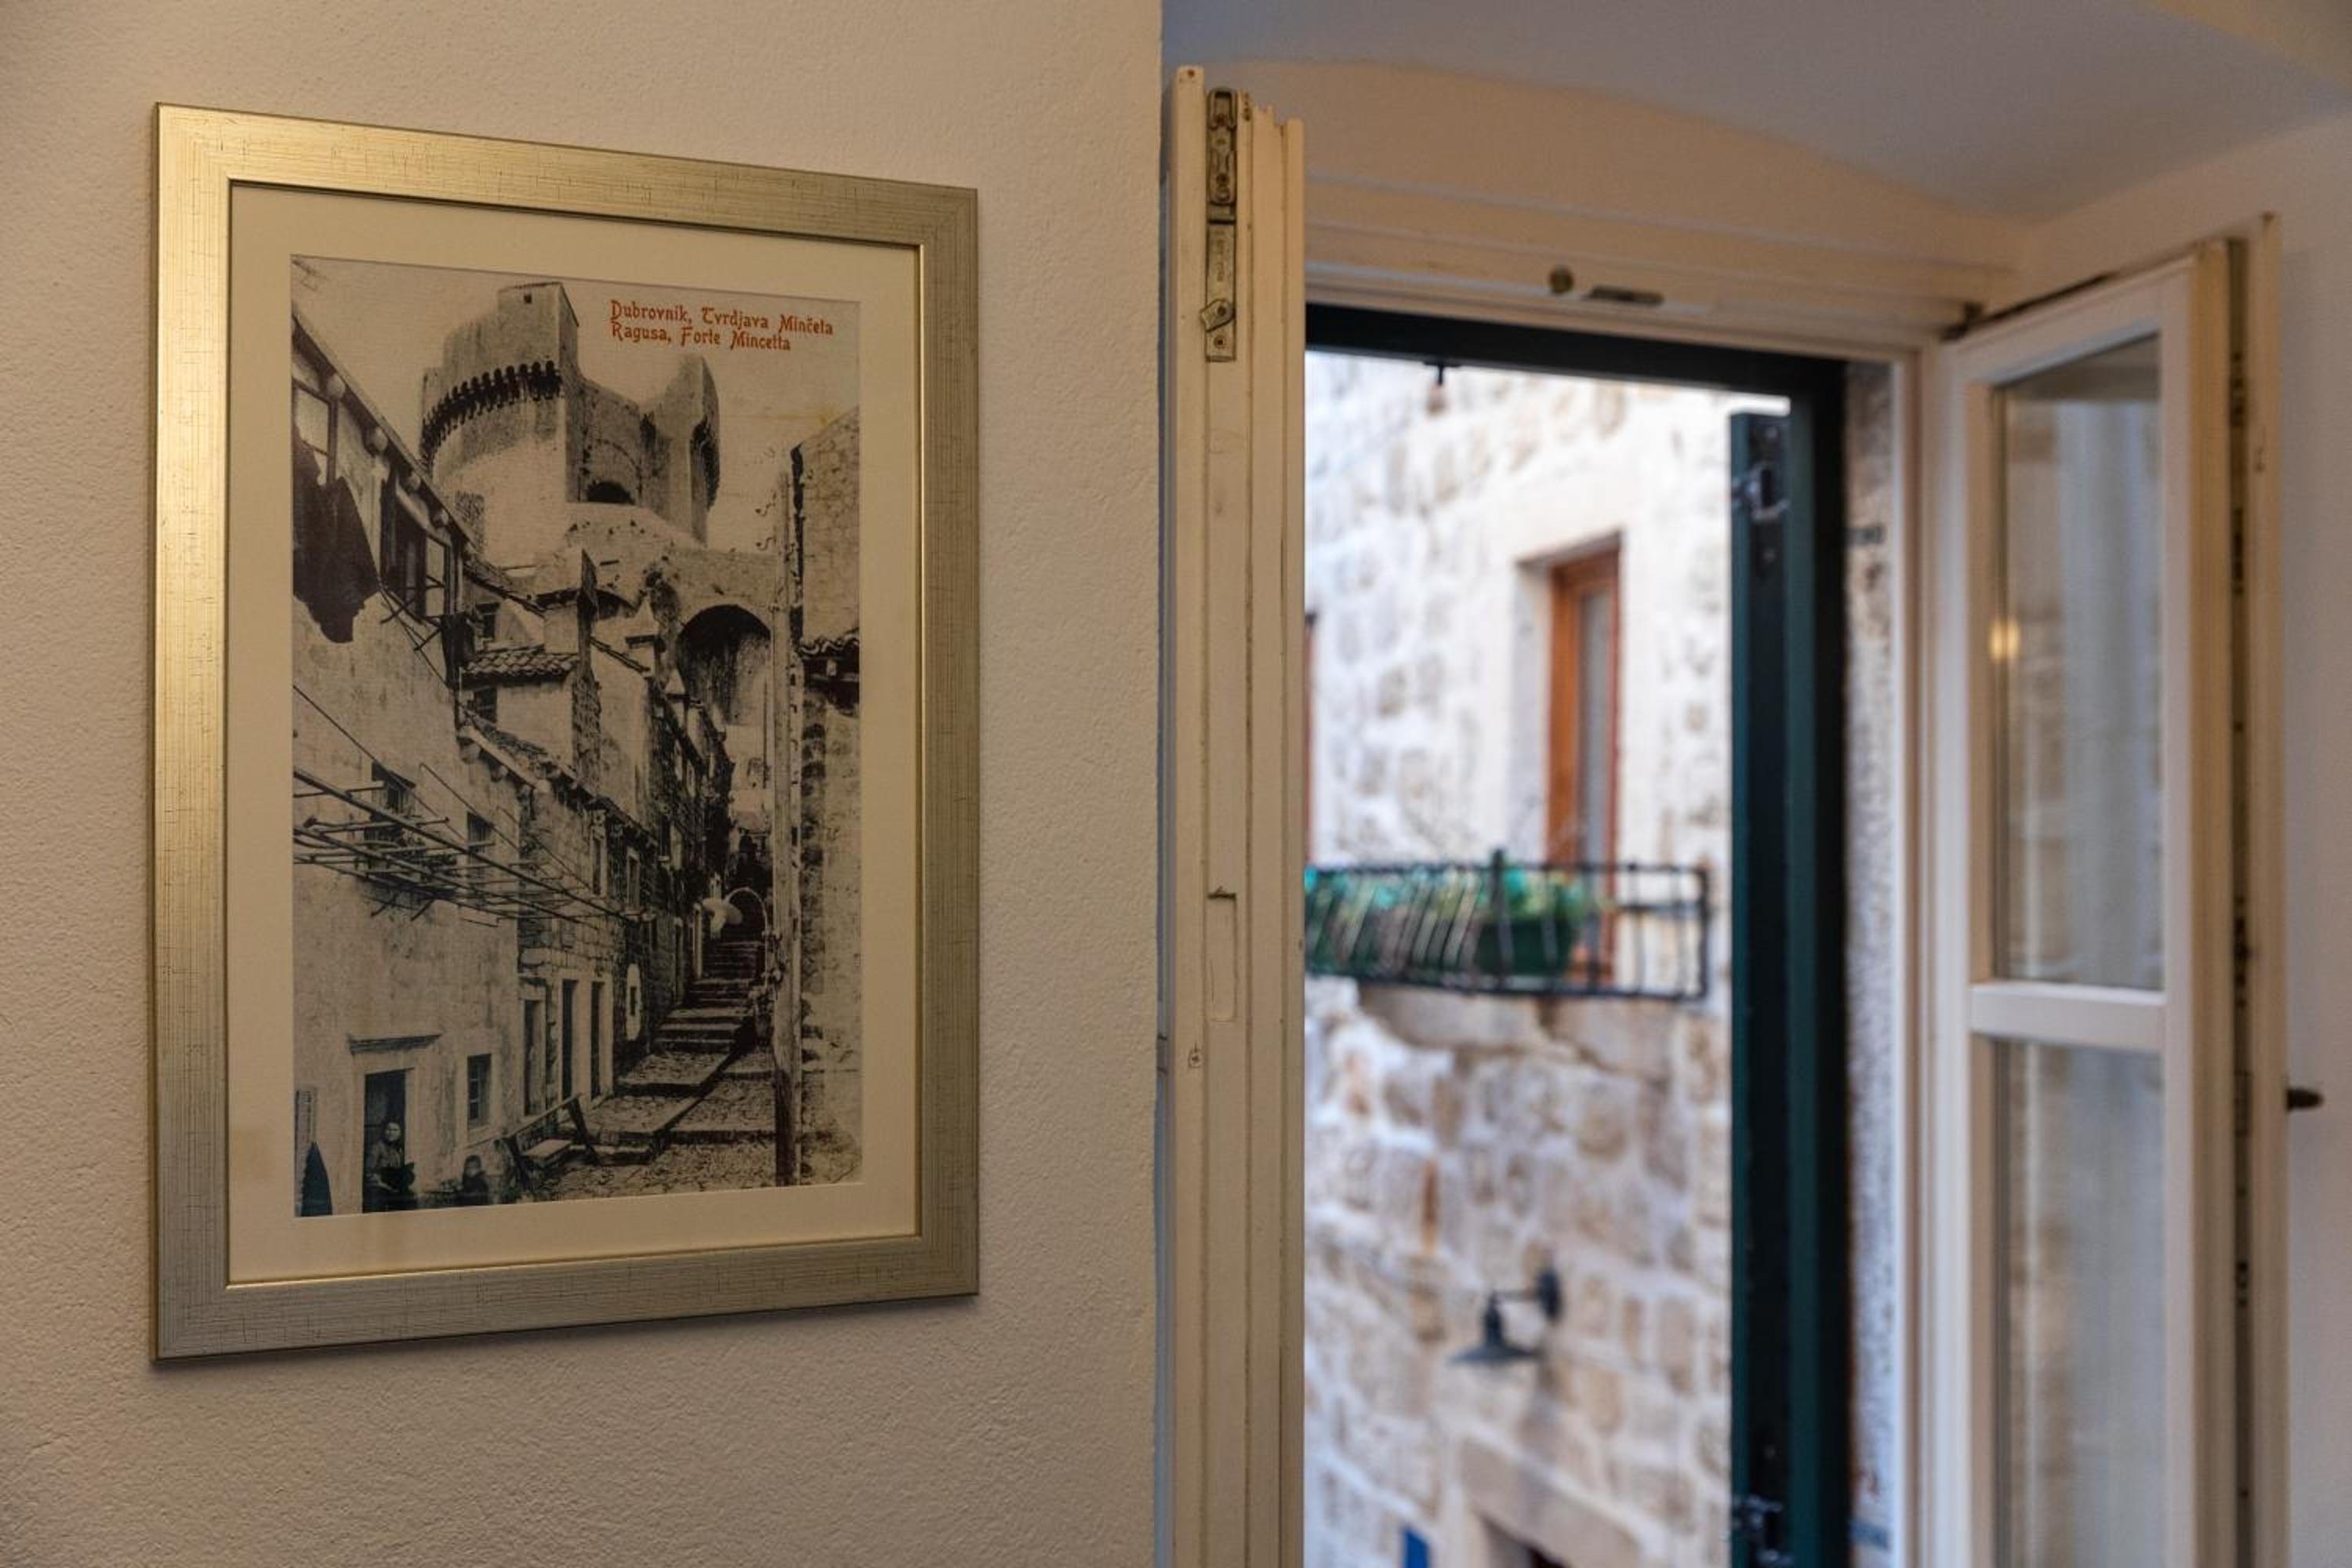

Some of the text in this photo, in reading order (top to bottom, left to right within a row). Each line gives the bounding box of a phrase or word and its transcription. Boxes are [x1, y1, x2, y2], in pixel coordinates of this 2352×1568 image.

[610, 299, 692, 325] Dubrovnik,
[702, 307, 768, 330] Tvrdjava
[611, 321, 791, 350] Ragusa, Forte Mincetta
